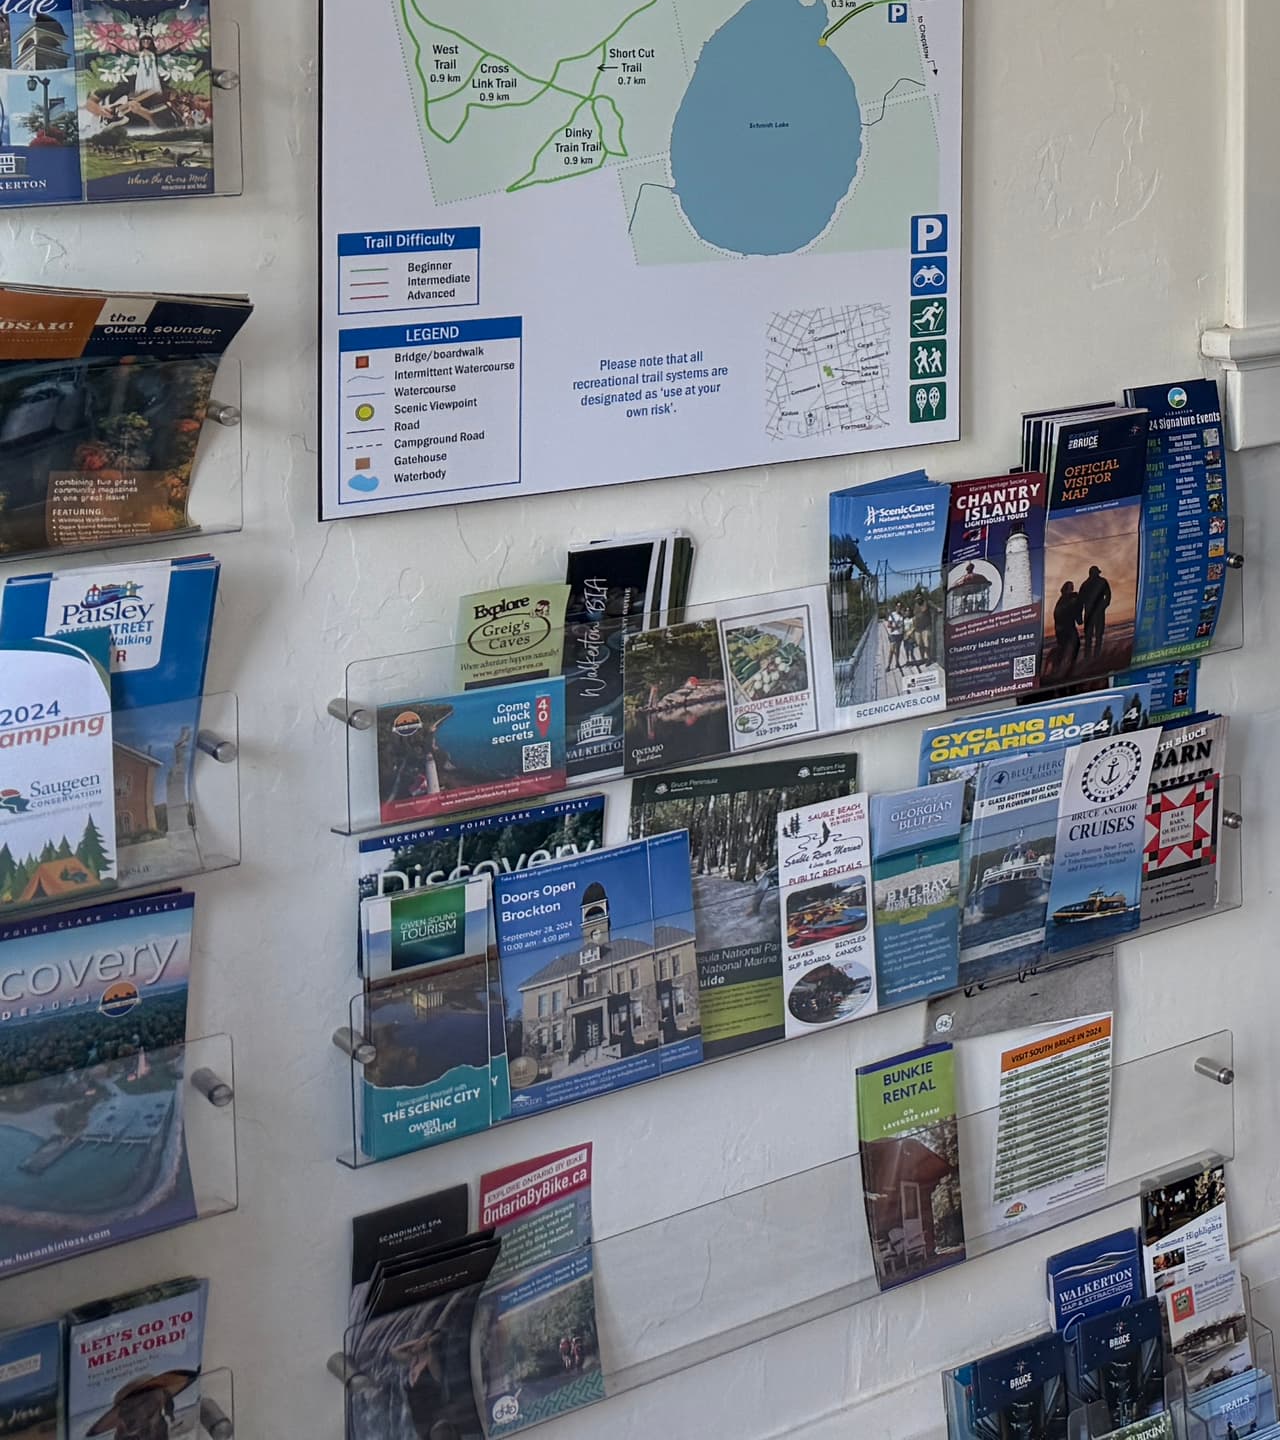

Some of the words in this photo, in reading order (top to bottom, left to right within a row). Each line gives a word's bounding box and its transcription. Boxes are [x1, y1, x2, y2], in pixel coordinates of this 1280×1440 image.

[433, 45, 459, 54] West
[609, 48, 636, 58] Short
[638, 49, 655, 58] Cut
[434, 60, 456, 70] Trail
[480, 63, 509, 74] Cross
[622, 63, 642, 72] Trail
[472, 78, 493, 89] Link
[496, 78, 516, 89] Trail
[565, 128, 592, 139] Dinky
[555, 143, 579, 153] Train
[581, 142, 602, 152] Trail
[364, 236, 392, 249] Trail
[396, 233, 455, 248] Difficulty
[917, 219, 942, 250] P
[408, 261, 452, 274] Beginner
[408, 274, 470, 286] Intermediate
[407, 289, 455, 300] Advanced
[110, 313, 136, 323] the
[104, 325, 147, 335] owen
[154, 326, 222, 336] sounder
[406, 326, 459, 342] LEGEND
[394, 347, 484, 363] Bridge/boardwalk
[600, 359, 636, 372] Please
[639, 356, 663, 368] note
[666, 354, 688, 365] that
[690, 351, 703, 362] all
[394, 367, 452, 380] Intermittent
[455, 361, 515, 375] Watercourse
[573, 375, 639, 390] recreational
[642, 372, 663, 383] trail
[666, 368, 708, 383] systems
[711, 366, 728, 376] are
[394, 384, 456, 397] Watercourse
[581, 390, 642, 408] designated
[645, 389, 657, 400] as
[661, 386, 682, 397] 'use
[685, 384, 696, 395] at
[698, 383, 720, 397] your
[394, 402, 427, 414] Scenic
[430, 398, 477, 412] Viewpoint
[626, 406, 648, 418] own
[394, 420, 420, 431] Road
[1158, 414, 1195, 430] Signature
[1197, 412, 1220, 424] Events
[394, 434, 458, 450] Campground
[460, 431, 485, 441] Road
[1073, 435, 1099, 448] BRUCE
[394, 452, 447, 466] Gatehouse
[1065, 459, 1119, 477] OFFICIAL
[394, 469, 446, 483] Waterbody
[1064, 472, 1112, 488] VISITOR
[957, 483, 1041, 510] CHANTRY
[1061, 488, 1089, 502] MAP
[965, 500, 1030, 522] ISLAND
[61, 601, 154, 627] Paisley
[474, 596, 530, 620] Explore
[482, 620, 530, 637] Greig's
[489, 635, 530, 650] Caves
[497, 701, 530, 713] Come
[734, 699, 774, 715] PRODUCE
[775, 692, 811, 708] MARKET
[856, 694, 940, 718] SCENICCAVES.COM
[1, 700, 61, 726] 2024
[493, 710, 530, 724] unlock
[512, 721, 530, 731] our
[931, 717, 1045, 749] CYCLING
[1049, 713, 1074, 728] IN
[492, 731, 533, 744] secrets
[930, 732, 1046, 762] ONTARIO
[1049, 720, 1109, 742] 2024
[30, 773, 100, 797] Saugeen
[30, 789, 101, 808] CONSERVATION
[383, 831, 436, 845] LUCKNOW
[460, 820, 493, 830] POINT
[498, 812, 531, 823] CLARK
[554, 801, 590, 813] RIPLEY
[1069, 815, 1135, 841] CRUISES
[789, 871, 820, 885] PUBLIC
[822, 861, 863, 877] RENTALS
[502, 889, 539, 905] Doors
[544, 880, 576, 896] Open
[502, 902, 561, 922] Brockton
[401, 919, 457, 941] TOURISM
[503, 928, 542, 944] September
[556, 921, 573, 932] 2024
[1011, 1051, 1029, 1064] VISIT
[1029, 1042, 1053, 1058] SOUTH
[1055, 1035, 1076, 1048] BRUCE
[1077, 1031, 1084, 1041] IN
[1086, 1027, 1102, 1039] 2024
[883, 1061, 933, 1087] BUNKIE
[882, 1080, 936, 1105] RENTAL
[382, 1111, 406, 1125] THE
[407, 1098, 452, 1117] SCENIC
[453, 1088, 480, 1104] CITY
[483, 1166, 587, 1225] OntarioByBike.ca
[1059, 1268, 1133, 1303] WALKERTON
[80, 1326, 133, 1355] LET'S
[137, 1319, 164, 1336] GO
[169, 1311, 193, 1328] TO
[1110, 1333, 1130, 1348] BRUCE
[87, 1328, 186, 1368] MEAFORD!
[1220, 1394, 1249, 1413] TRAILS
